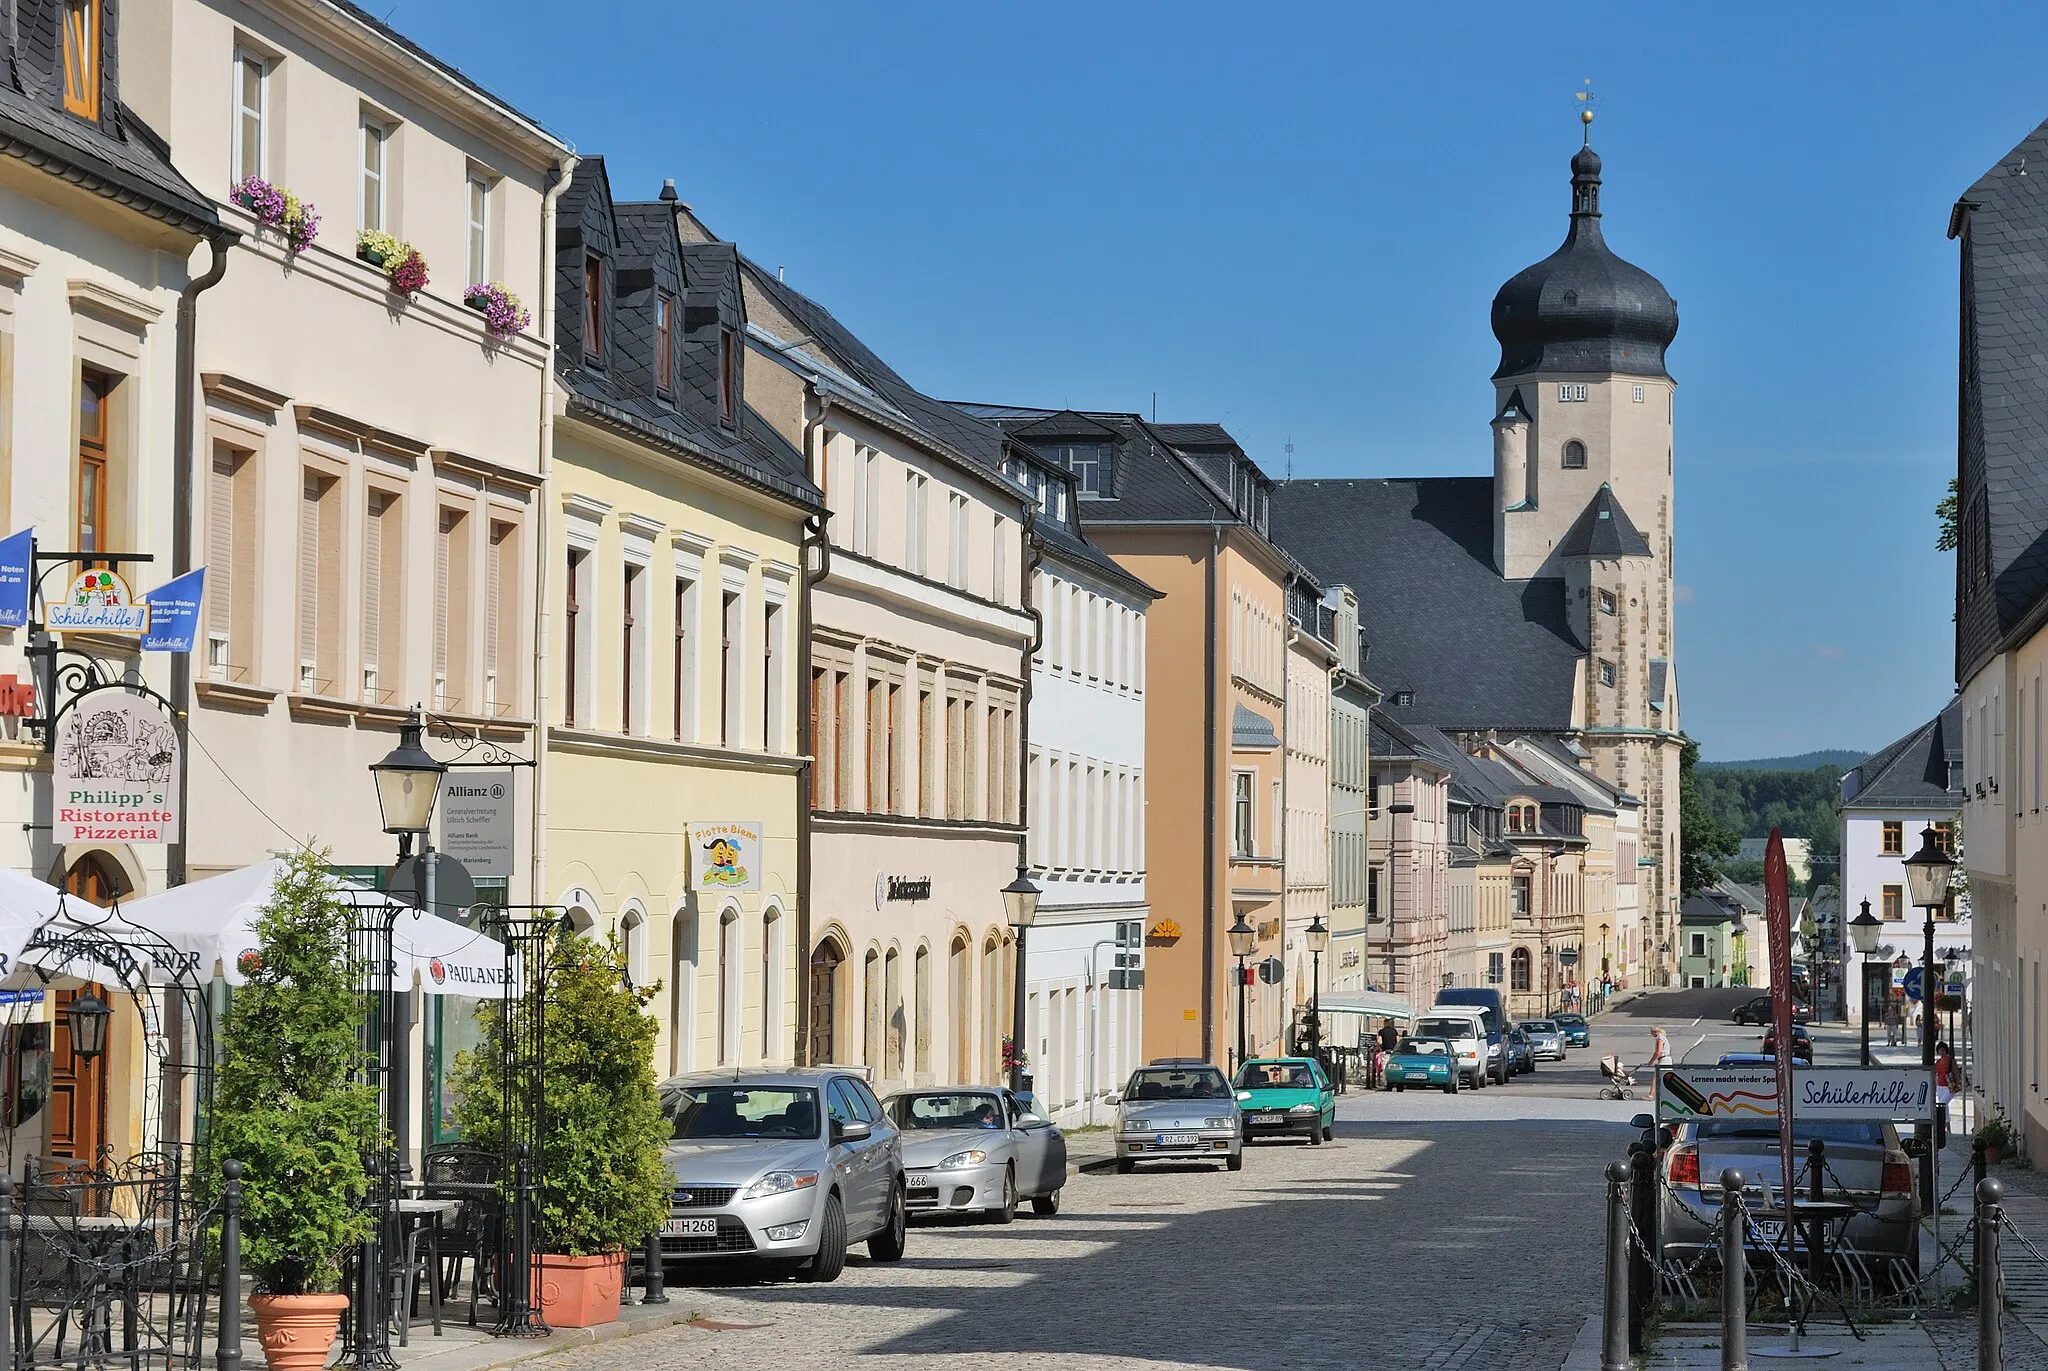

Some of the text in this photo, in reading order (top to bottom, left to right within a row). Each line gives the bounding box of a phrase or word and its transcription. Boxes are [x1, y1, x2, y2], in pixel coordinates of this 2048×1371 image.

[1, 565, 24, 573] Noten
[50, 605, 135, 630] Schülerhilfe
[448, 787, 487, 797] Allianz
[59, 808, 173, 822] Ristorante
[447, 807, 496, 816] Generalvertretung
[73, 825, 158, 839] Pizzeria
[695, 824, 758, 841] Flotte Biene
[463, 857, 492, 865] Marienberg
[447, 962, 517, 984] PAULANER
[1691, 1075, 1776, 1085] Lernen macht wieder Spa
[1802, 1080, 1915, 1111] Schülerhilfe
[910, 1176, 927, 1187] 666
[681, 1221, 690, 1233] H
[692, 1220, 715, 1232] 268
